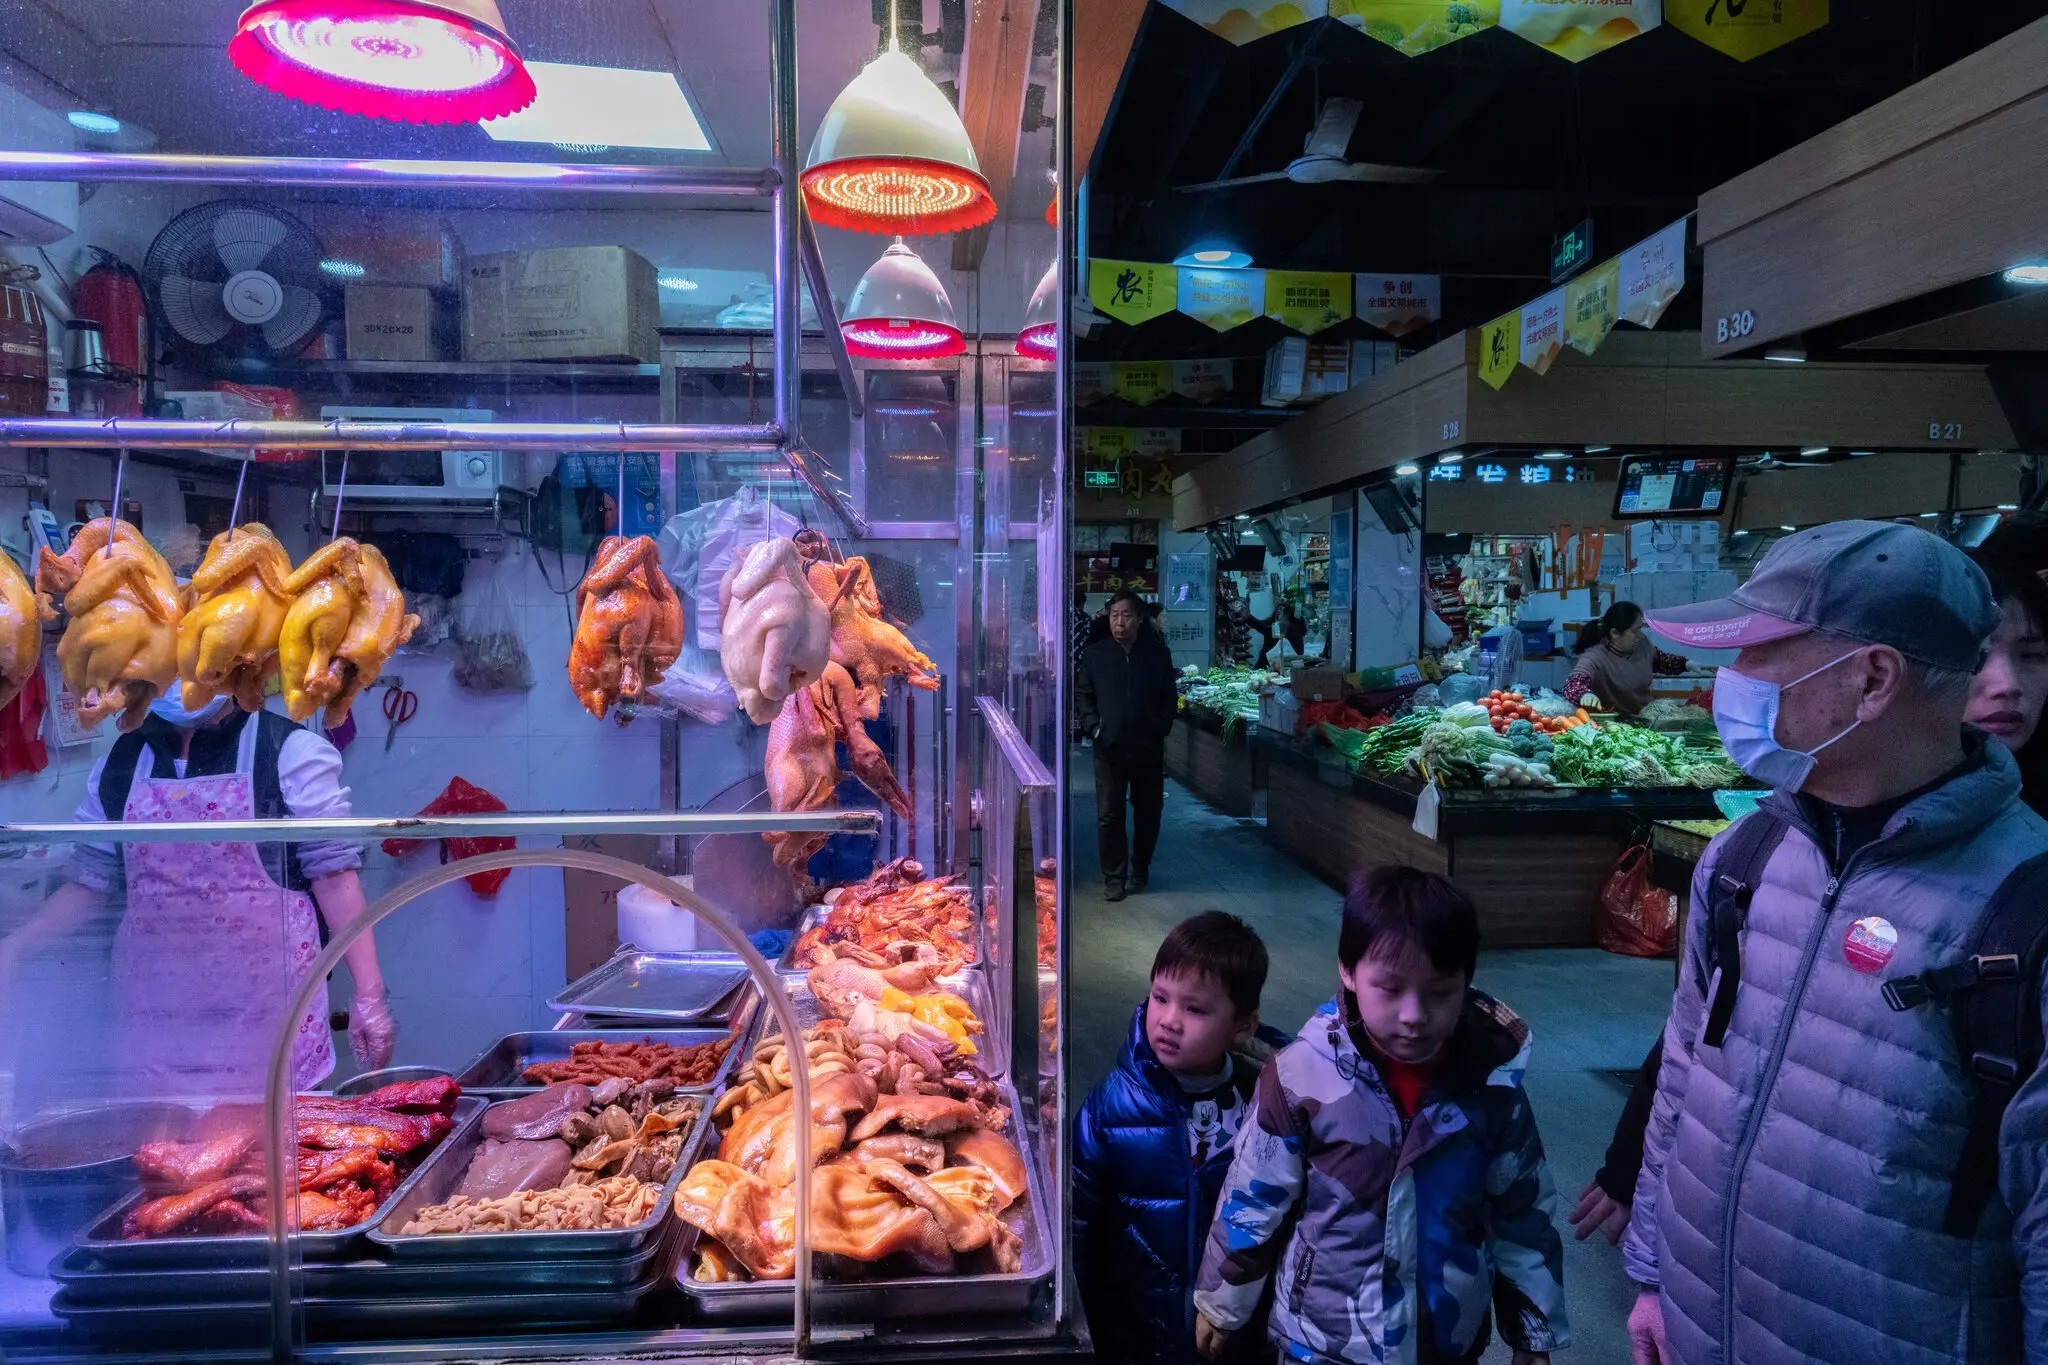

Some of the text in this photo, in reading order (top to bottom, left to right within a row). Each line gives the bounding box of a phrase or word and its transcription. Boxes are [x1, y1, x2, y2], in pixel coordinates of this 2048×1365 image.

[1110, 268, 1144, 306] 农
[1383, 280, 1413, 295] 争创
[1367, 297, 1428, 309] 全国文明城市
[1717, 309, 1754, 343] B30
[1442, 420, 1460, 441] B28
[1928, 423, 1963, 440] B21
[1075, 572, 1155, 592] 牛肉丸
[1684, 617, 1752, 635] le coq sportif
